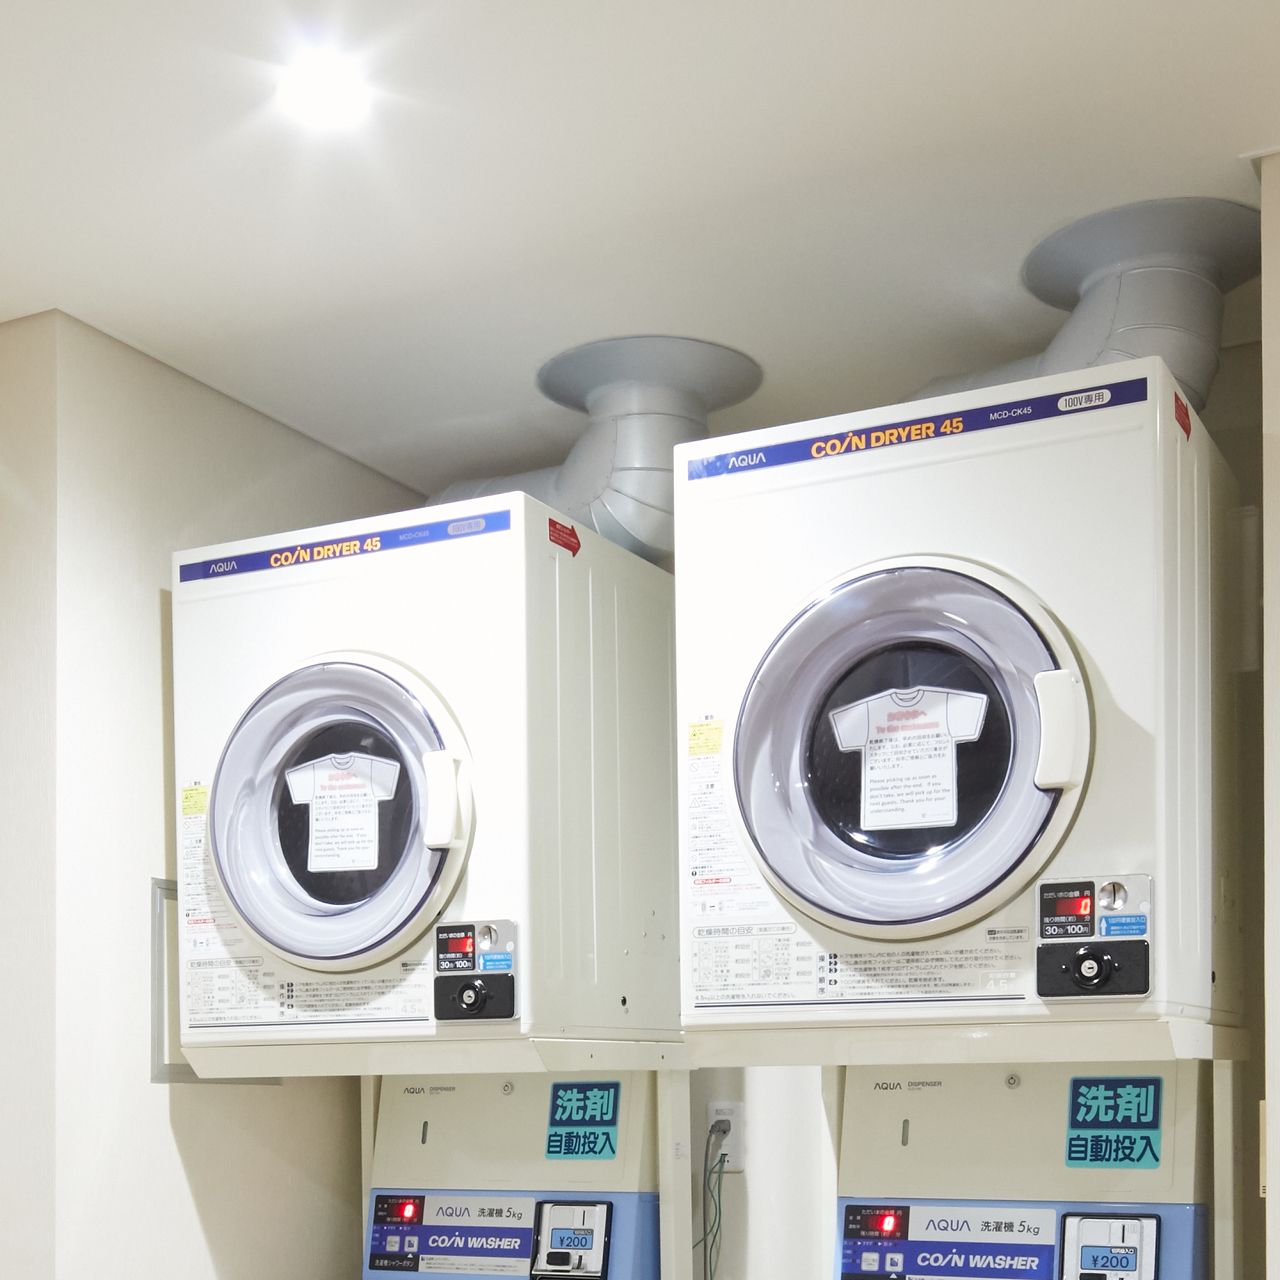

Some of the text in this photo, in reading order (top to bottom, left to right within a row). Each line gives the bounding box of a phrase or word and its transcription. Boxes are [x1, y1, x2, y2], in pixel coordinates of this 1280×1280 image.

[1064, 392, 1104, 409] 100V専用
[728, 451, 766, 469] AQUA
[870, 422, 935, 448] DRYER
[940, 417, 963, 434] 45
[989, 406, 1032, 421] MCD-CK45
[210, 561, 237, 573] AQUA
[314, 539, 361, 560] DRYER
[363, 537, 381, 551] 45
[1081, 898, 1090, 915] 0
[874, 1082, 902, 1090] AQUA
[555, 1088, 614, 1121] 洗剤
[1076, 1084, 1154, 1123] 洗剤
[547, 1131, 615, 1155] 自動投入
[1068, 1134, 1160, 1162] 自動投入
[436, 1206, 523, 1220] AQUA 洗濯機 5kg
[883, 1216, 894, 1230] 0
[926, 1219, 1040, 1236] AQUA 洗濯機 5kg
[468, 1237, 521, 1249] WASHER
[559, 1236, 587, 1247] ¥200
[969, 1255, 1039, 1270] WASHER
[1091, 1255, 1129, 1268] ¥200
